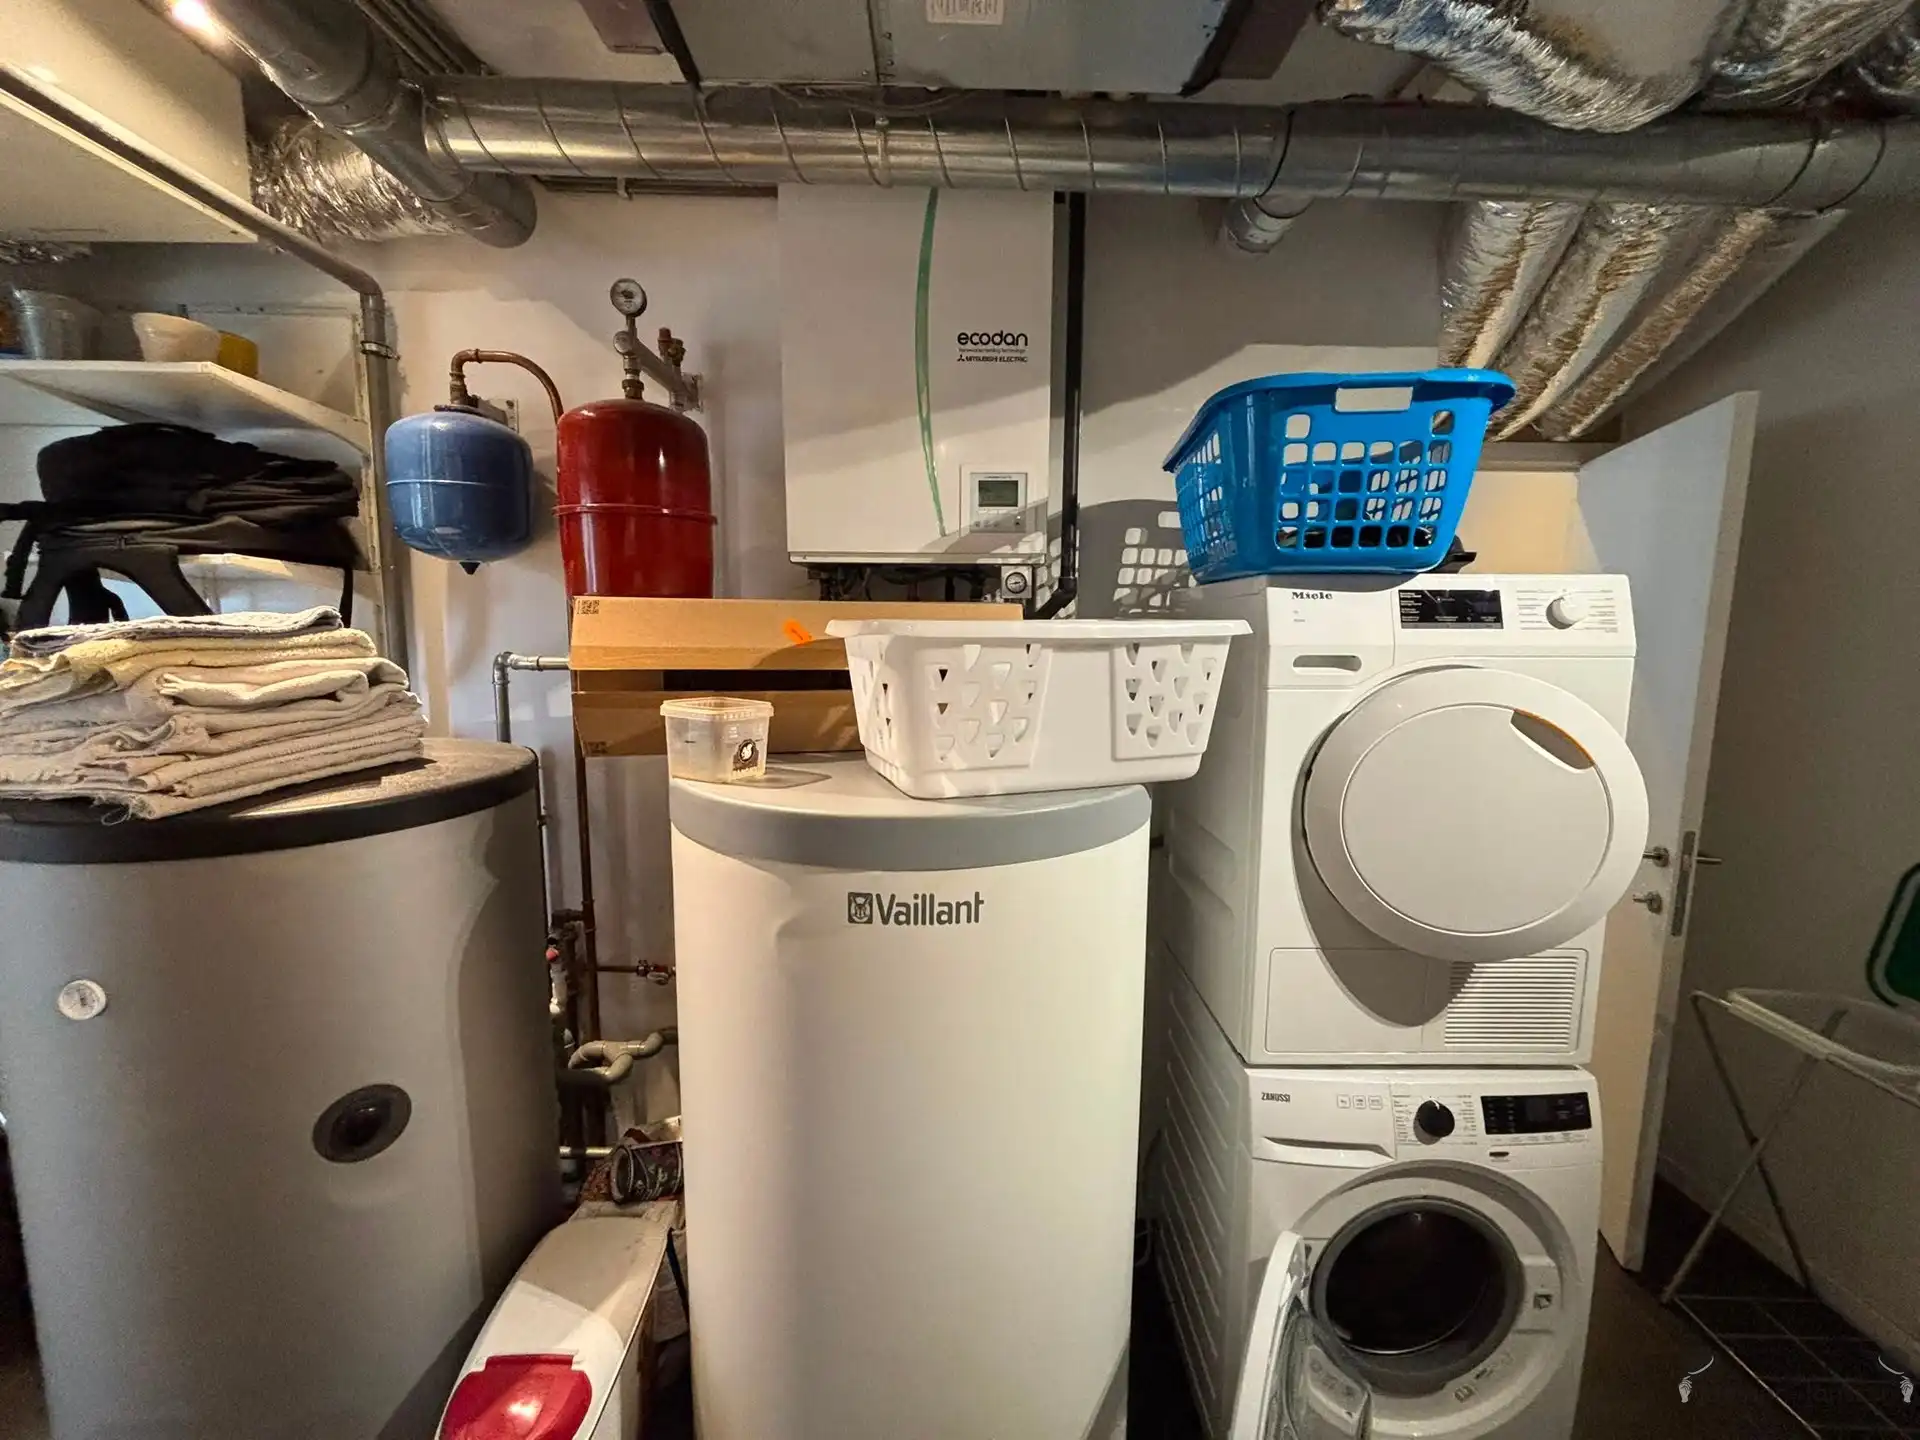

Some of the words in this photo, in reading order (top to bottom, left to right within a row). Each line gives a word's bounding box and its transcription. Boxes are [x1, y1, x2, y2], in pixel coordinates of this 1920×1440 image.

[957, 330, 1028, 346] ecodan
[1291, 591, 1334, 600] Miele
[875, 891, 985, 926] Vaillant
[1261, 1091, 1291, 1103] ZANUSSI
